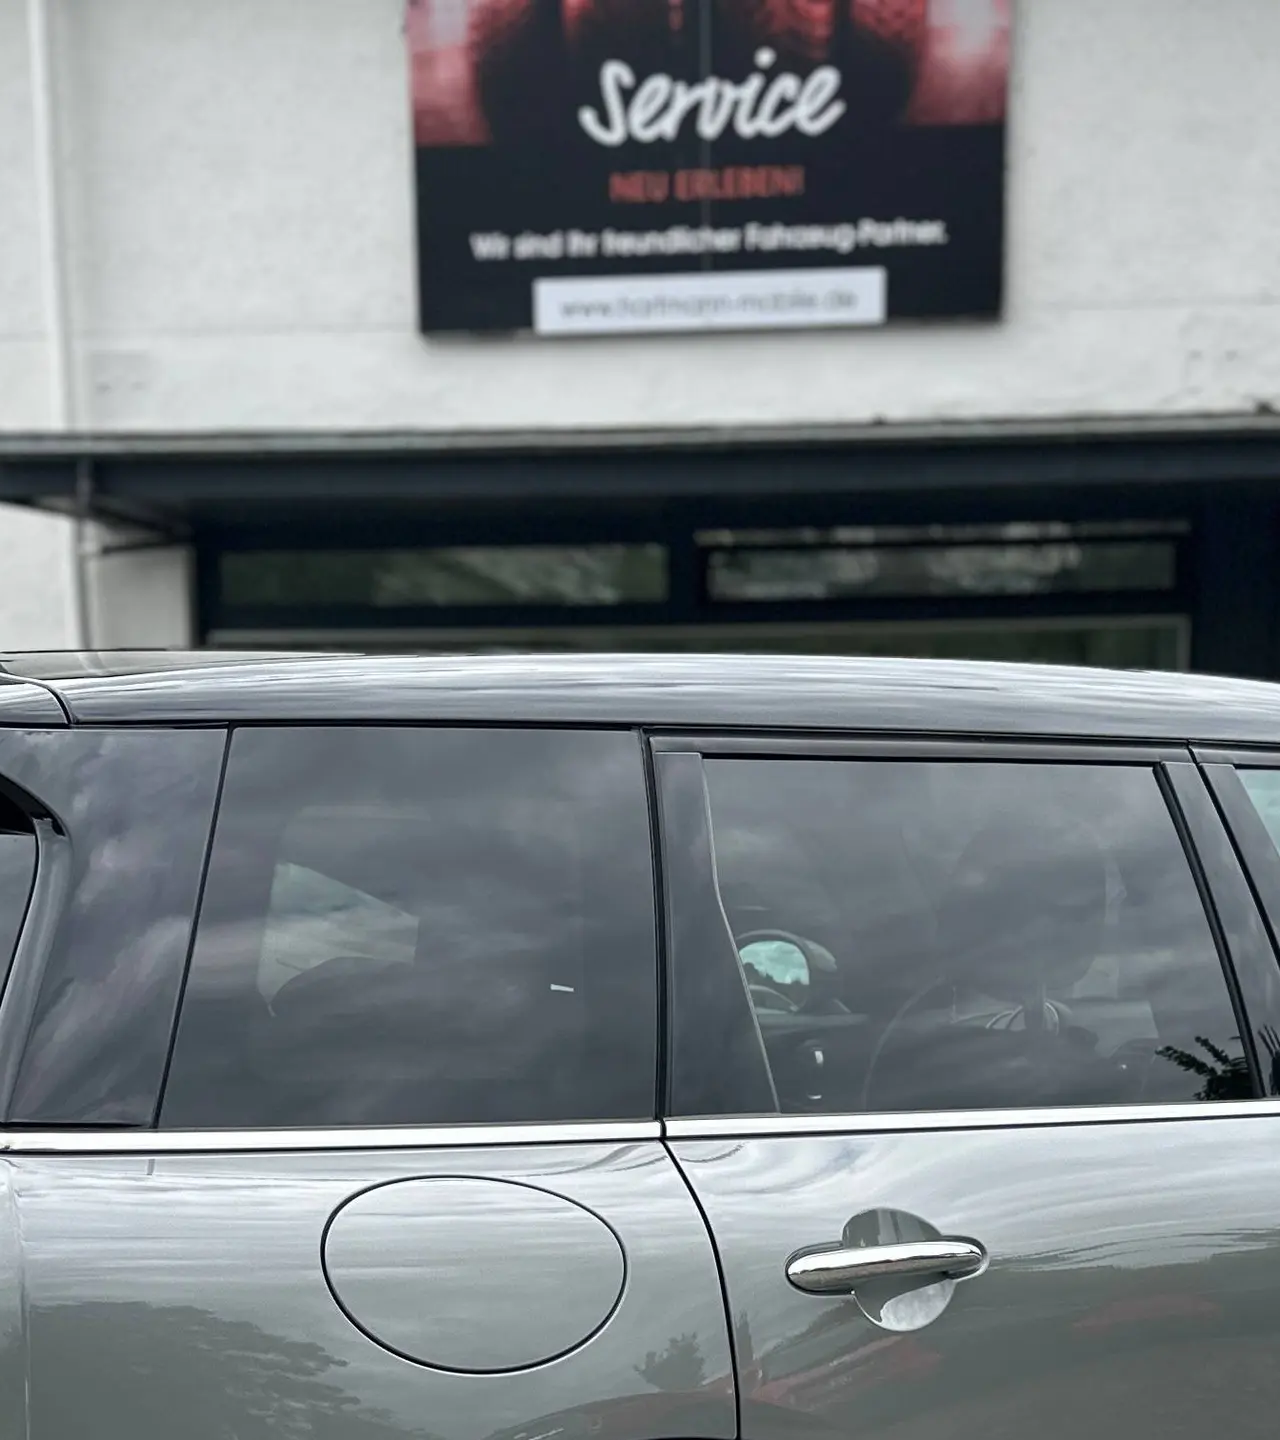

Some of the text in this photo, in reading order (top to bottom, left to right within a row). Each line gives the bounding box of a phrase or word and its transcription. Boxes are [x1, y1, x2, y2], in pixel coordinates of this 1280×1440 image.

[578, 47, 846, 146] Service
[608, 165, 805, 203] NEU ERLEBEN!
[469, 232, 510, 261] Wir
[514, 229, 563, 260] sind
[566, 229, 599, 258] Ihr
[601, 222, 741, 258] freundlicher
